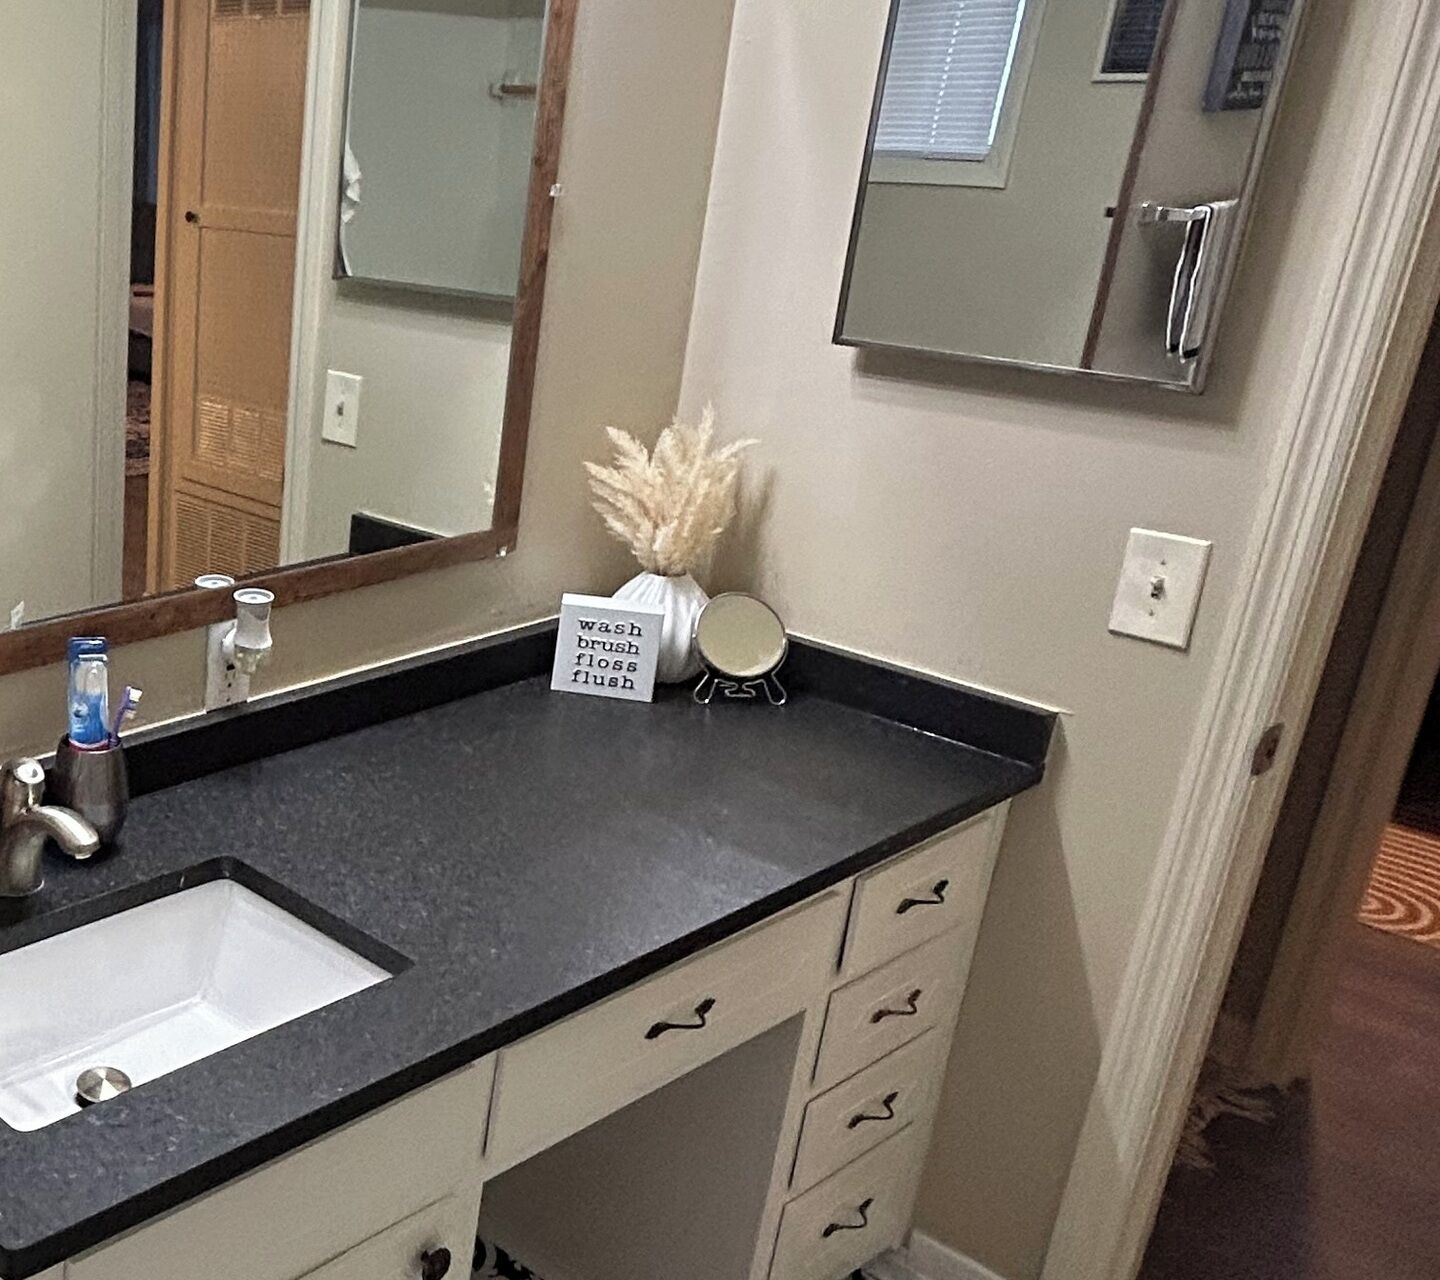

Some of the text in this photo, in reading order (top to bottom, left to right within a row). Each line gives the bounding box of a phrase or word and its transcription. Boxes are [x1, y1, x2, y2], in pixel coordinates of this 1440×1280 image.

[578, 619, 642, 637] wash
[576, 634, 640, 655] brush
[574, 652, 638, 672] floss
[571, 669, 635, 690] flush
